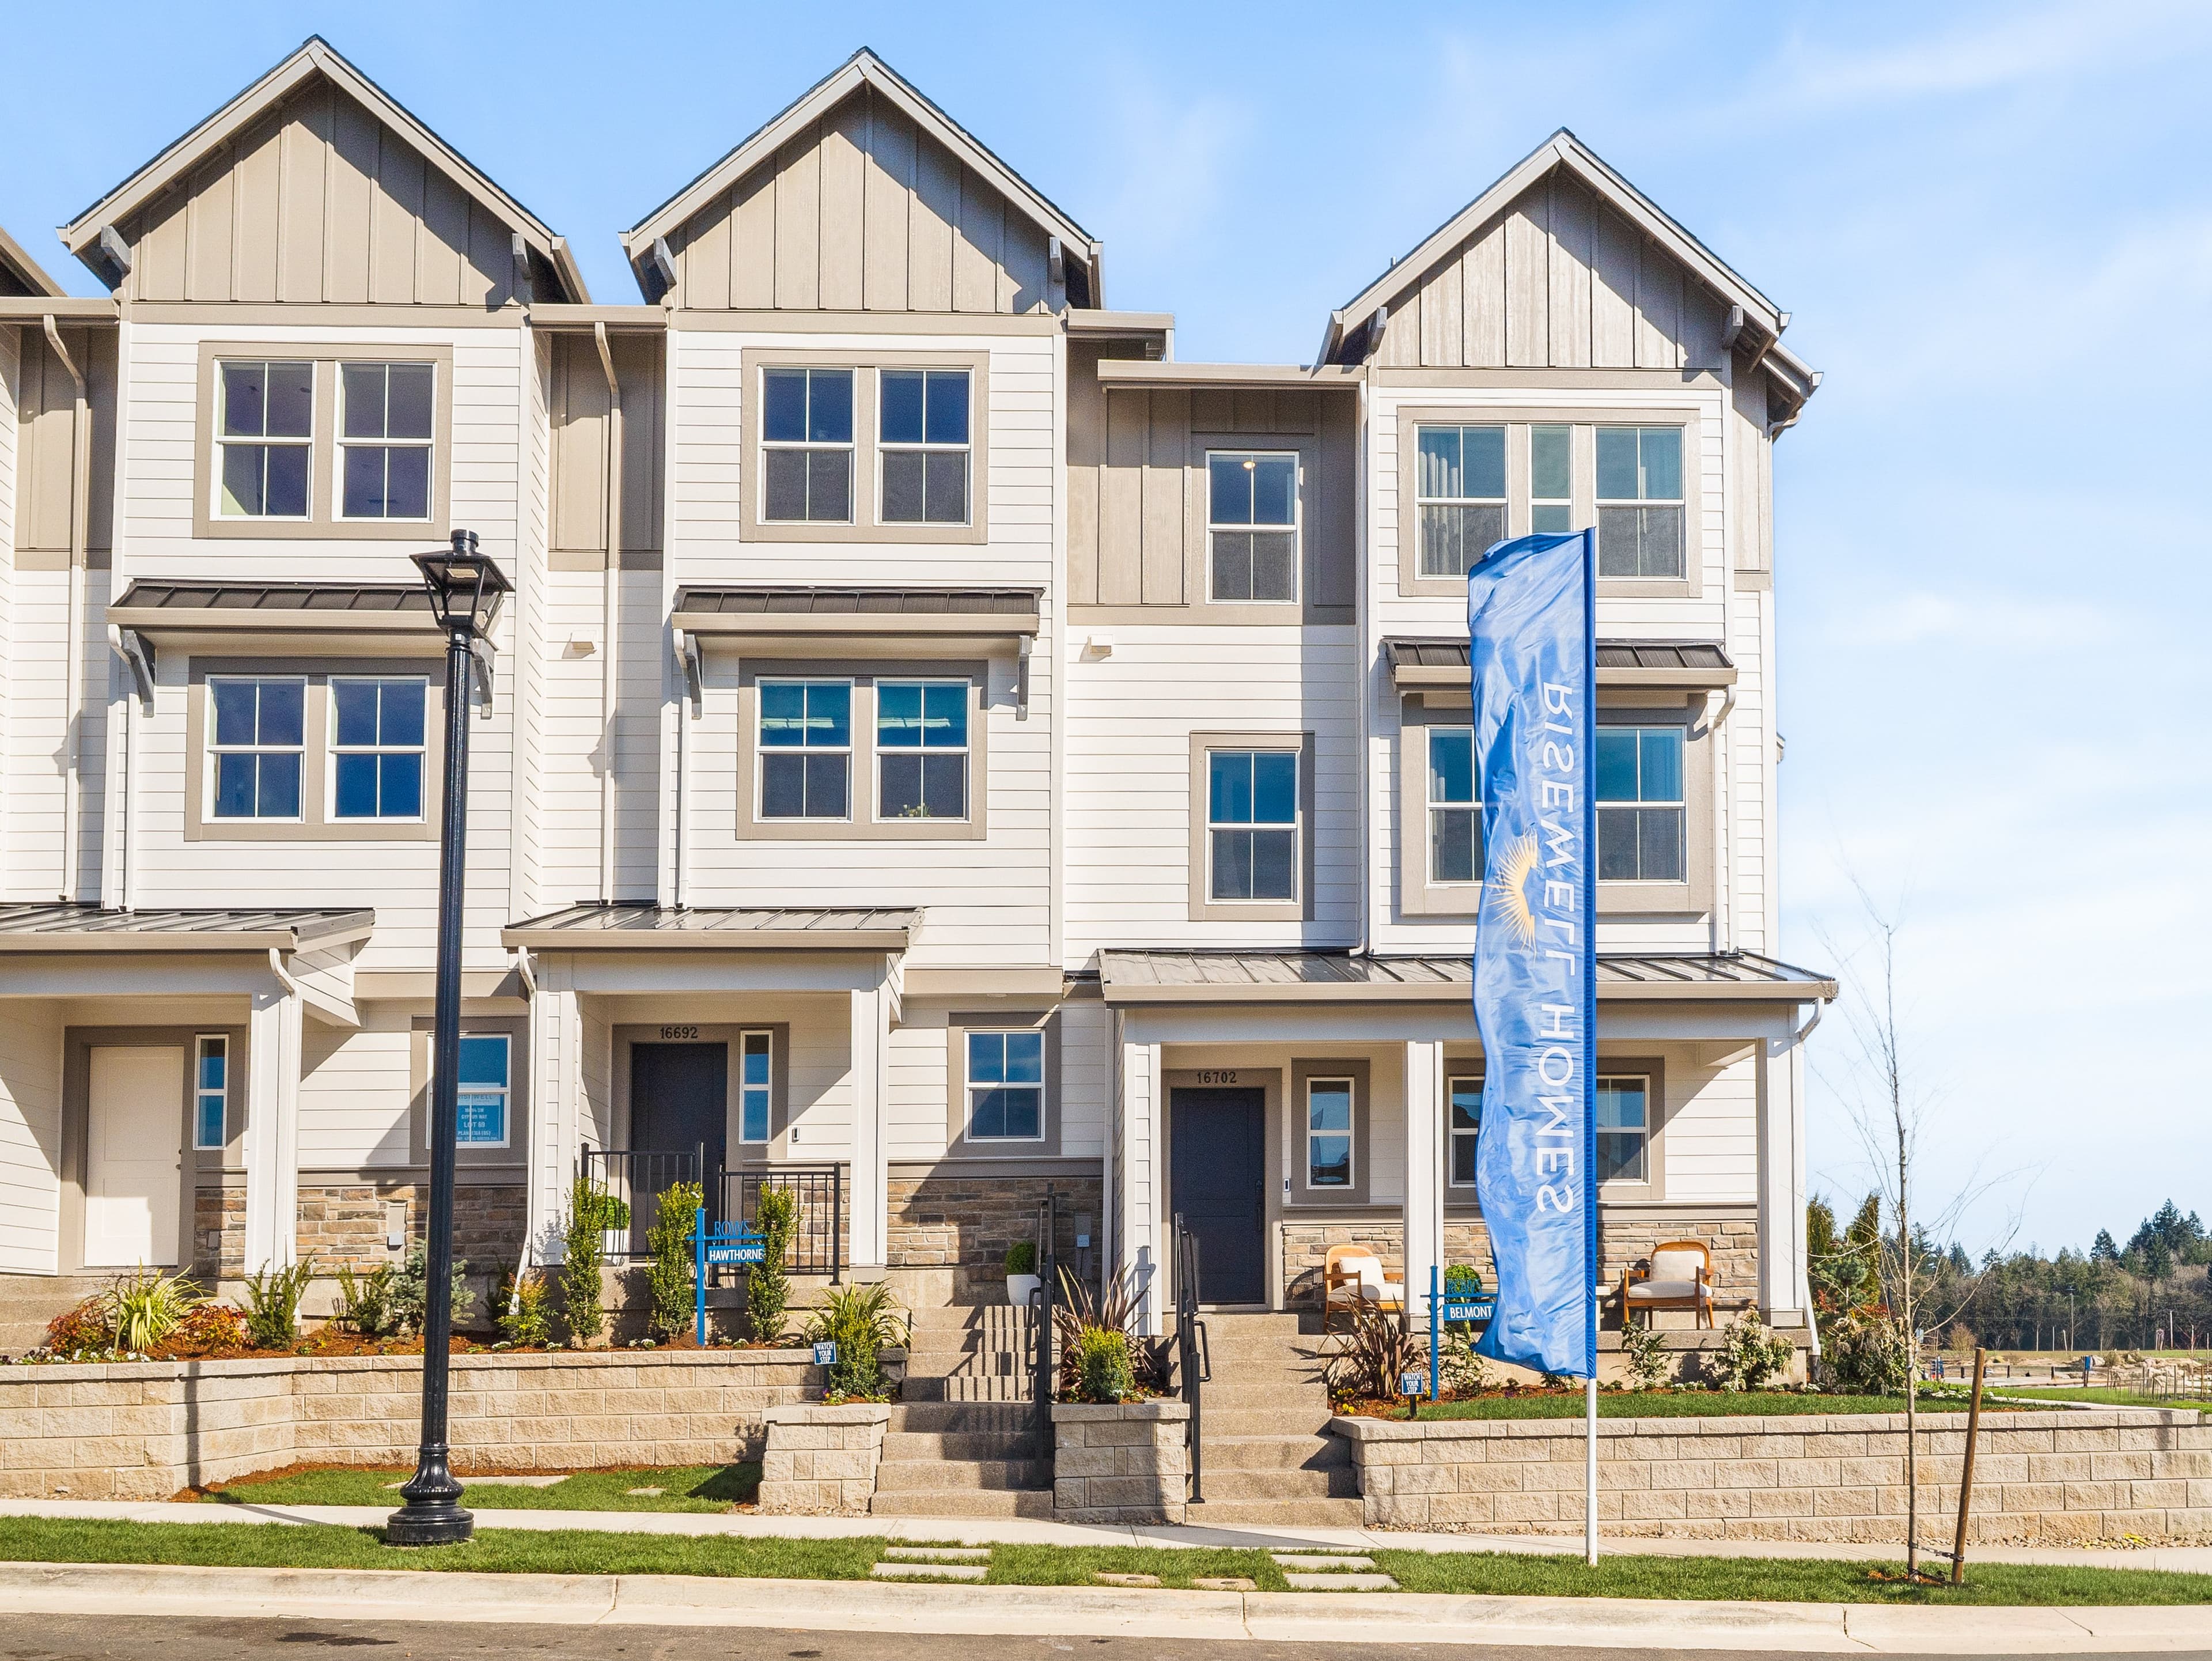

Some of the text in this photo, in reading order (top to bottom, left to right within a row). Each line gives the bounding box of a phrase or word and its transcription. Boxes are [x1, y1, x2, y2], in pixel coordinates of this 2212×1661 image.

[660, 1027, 698, 1039] 16692
[1197, 1072, 1237, 1083] 16702
[714, 1220, 750, 1236] ROWS
[709, 1248, 763, 1261] HAWTHORNE
[1450, 1306, 1493, 1319] BELMONT
